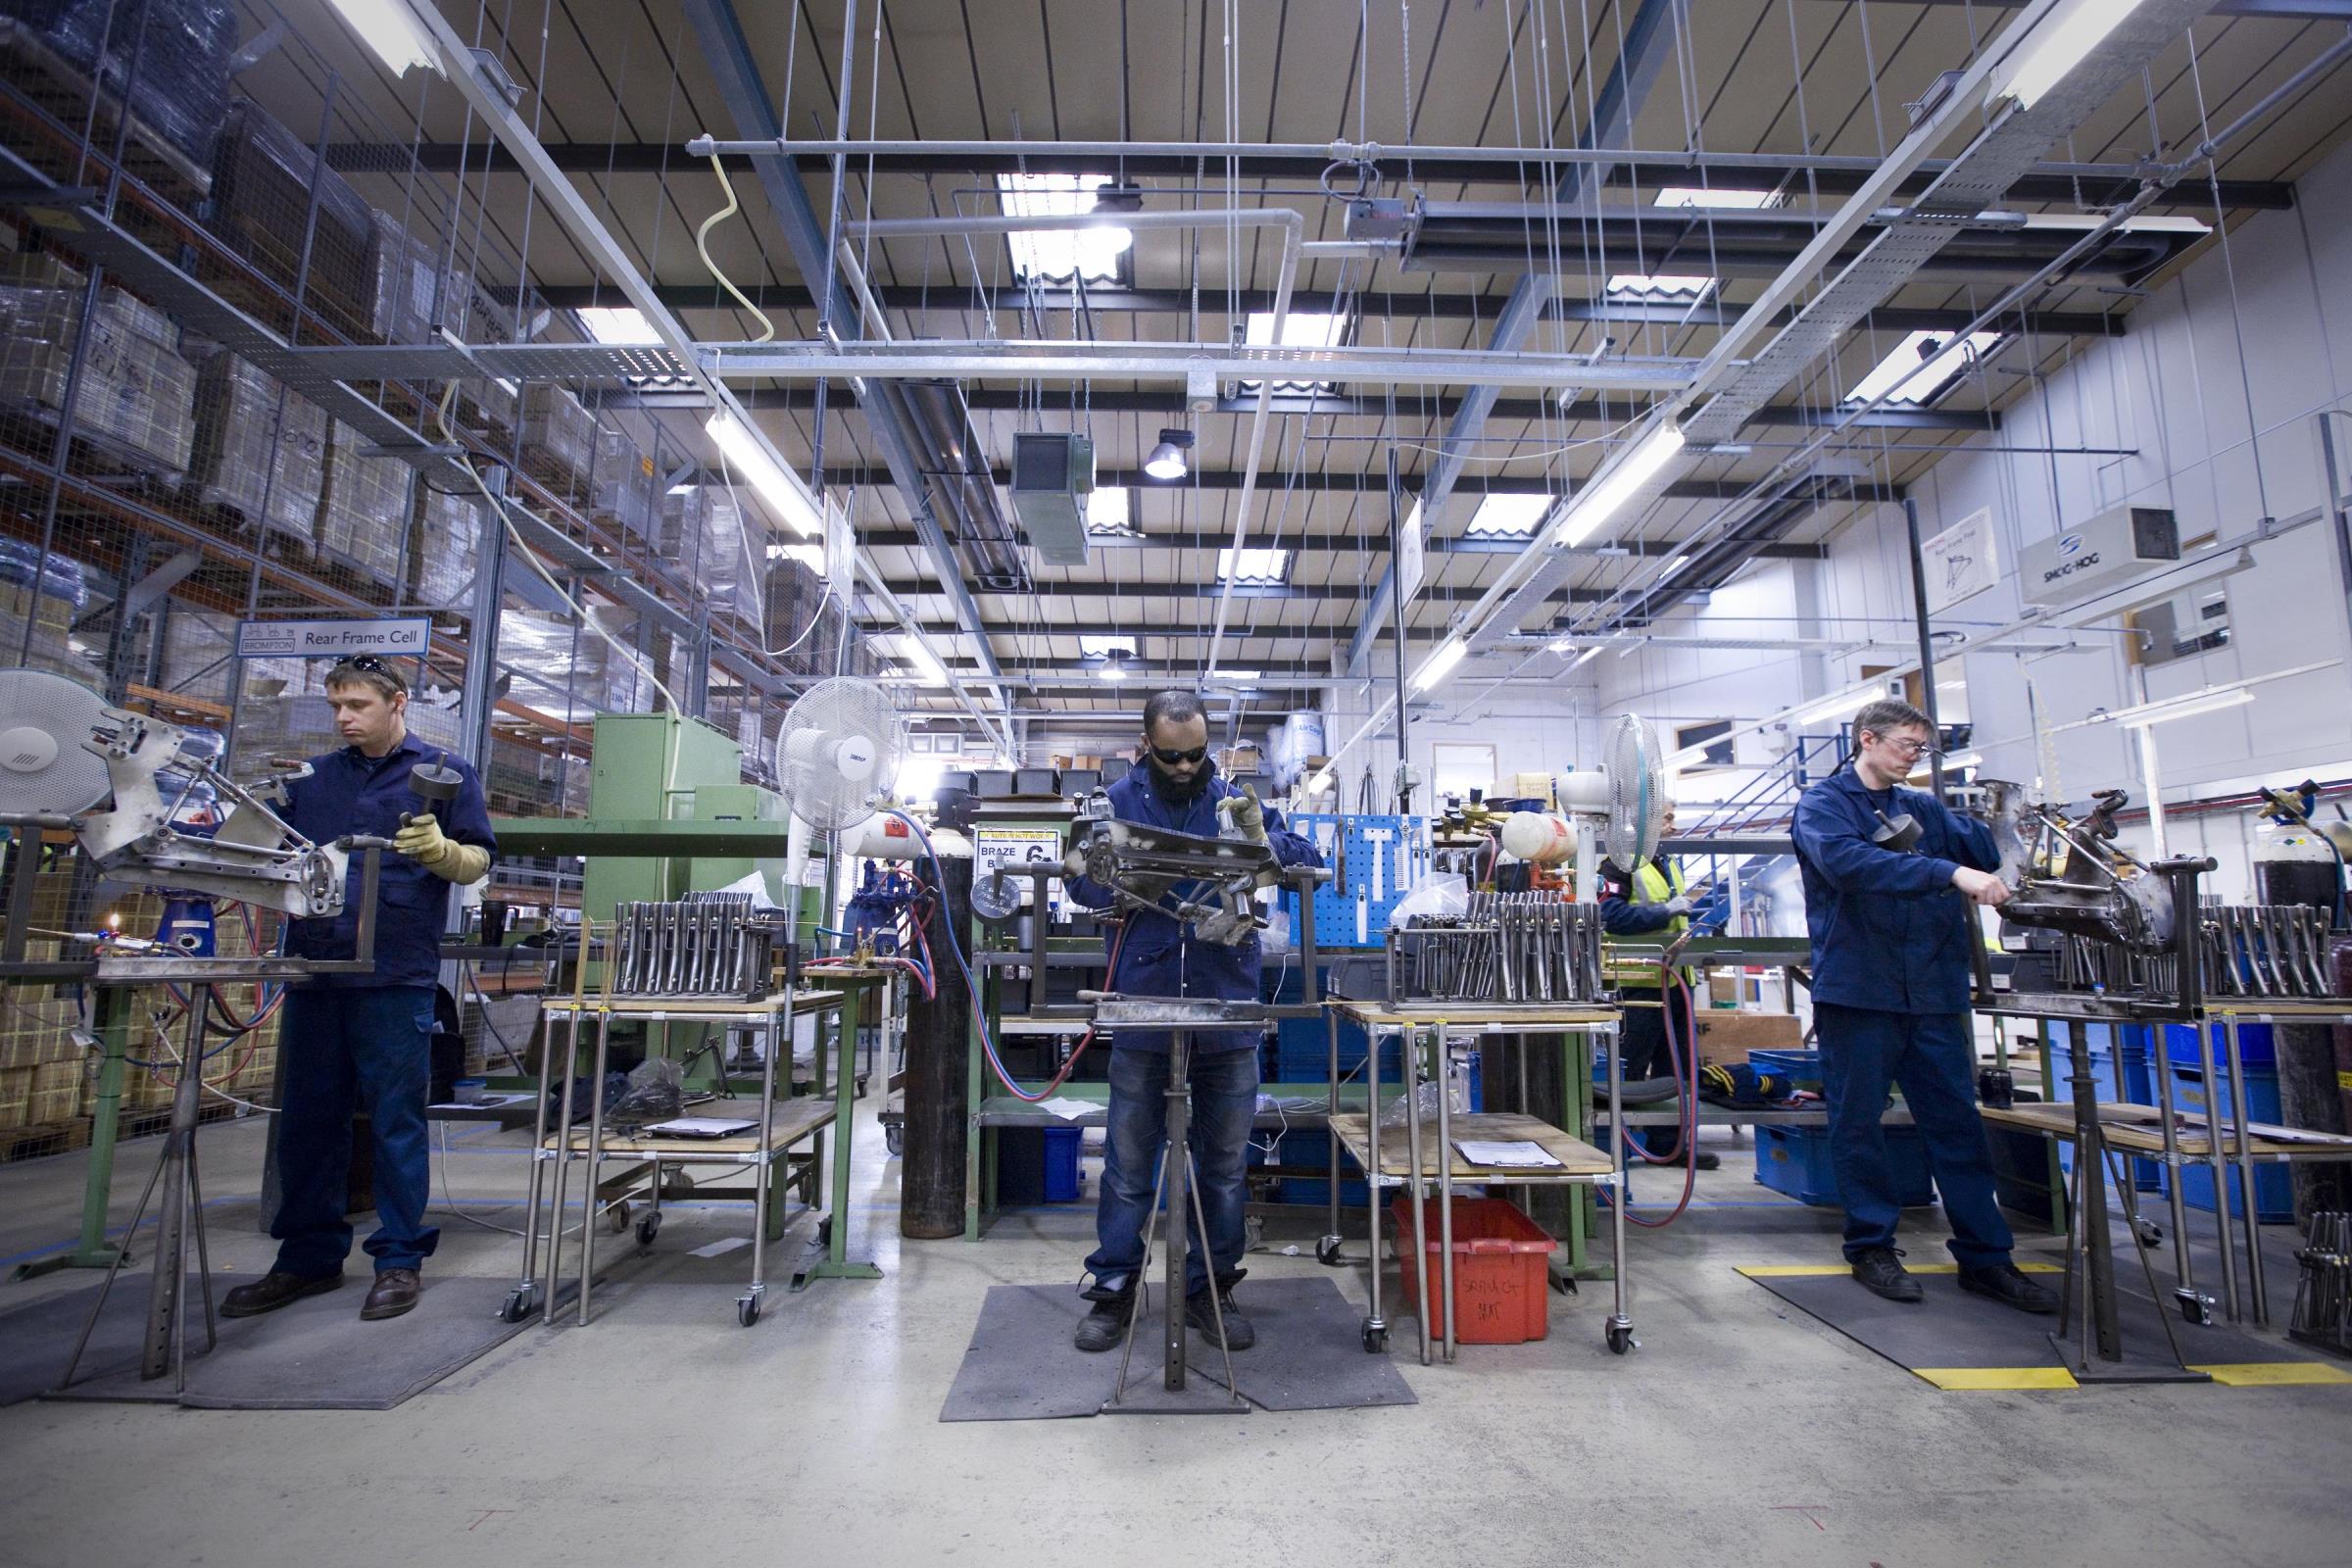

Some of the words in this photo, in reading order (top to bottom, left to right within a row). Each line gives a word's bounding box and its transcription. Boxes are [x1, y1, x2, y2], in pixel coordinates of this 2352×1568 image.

[306, 632, 338, 645] Rear
[342, 631, 385, 644] Frame
[390, 630, 417, 644] Cell
[244, 641, 292, 651] BROMPTON
[981, 847, 1016, 857] BRAZE
